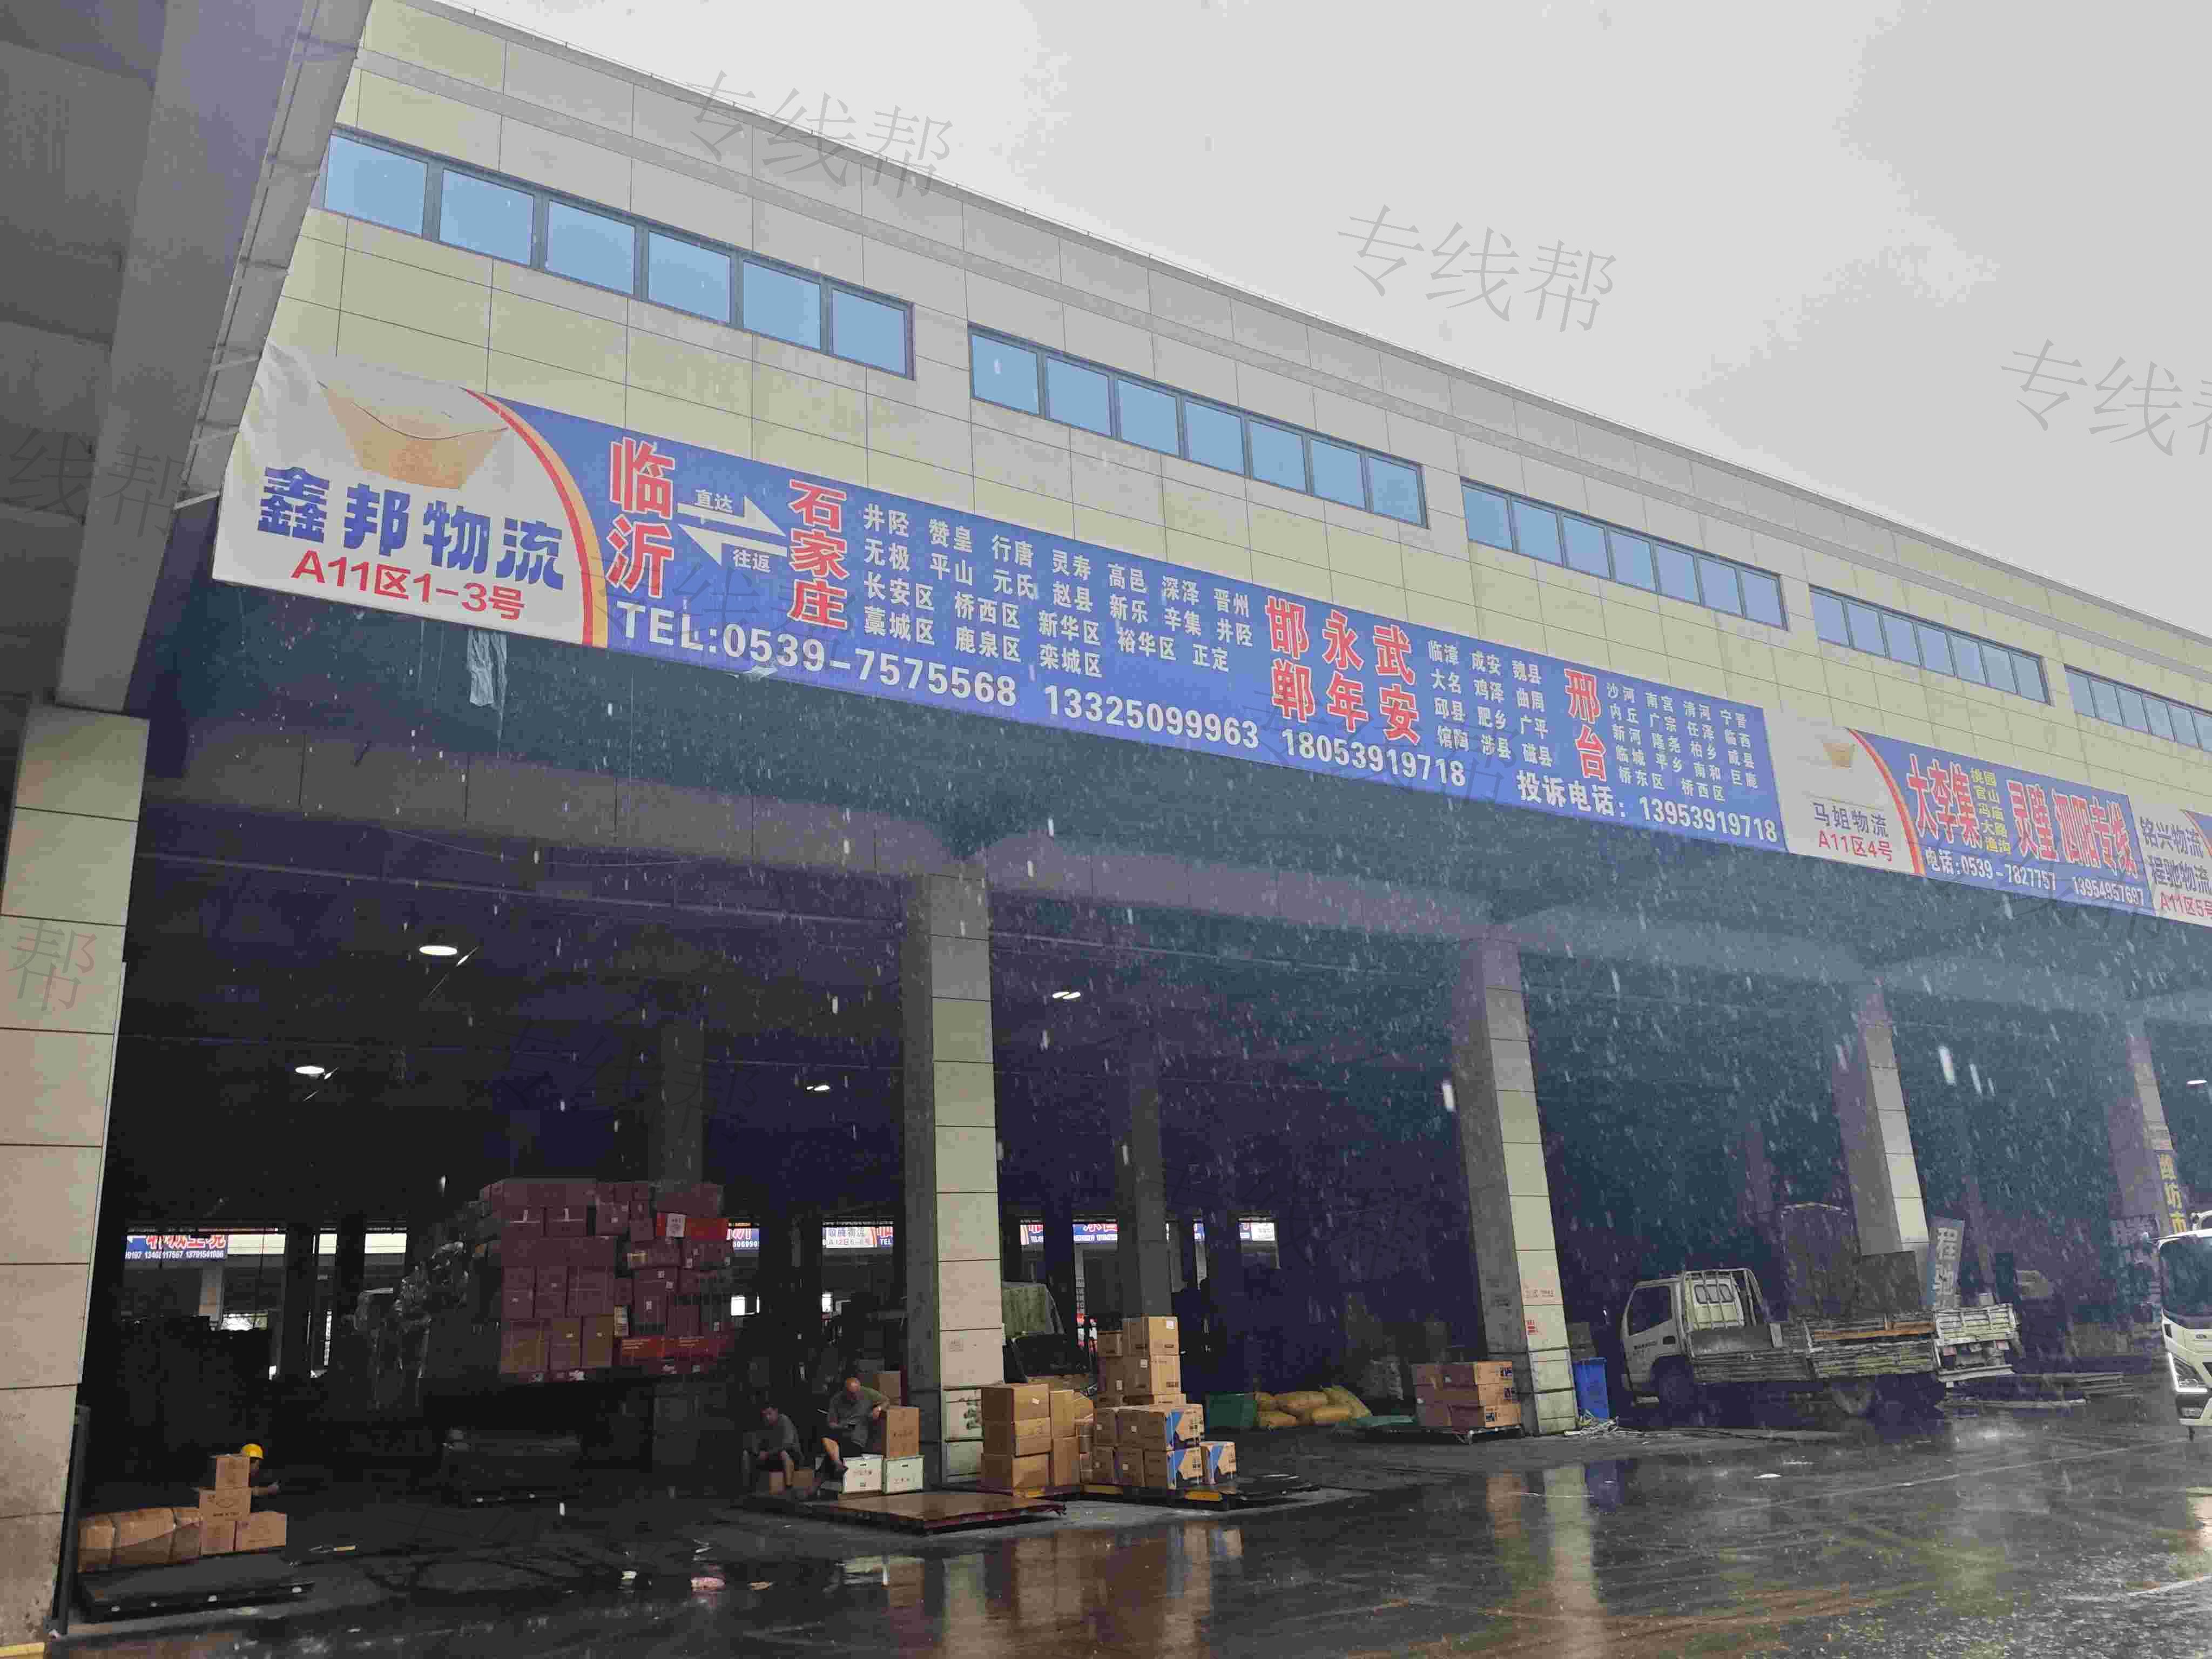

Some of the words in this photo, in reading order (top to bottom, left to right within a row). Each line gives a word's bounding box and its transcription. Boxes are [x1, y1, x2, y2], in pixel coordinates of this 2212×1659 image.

[257, 466, 563, 590] 鑫邦物流
[605, 436, 676, 599] 临沂
[695, 489, 733, 514] 直达
[787, 478, 848, 630] 石家庄
[291, 549, 525, 621] A11区1-3号
[733, 548, 771, 574] 往返
[864, 503, 909, 537] 井陉
[929, 518, 973, 553] 赞皇
[992, 534, 1034, 568] 行唐
[1052, 548, 1091, 581] 灵寿
[1107, 562, 1149, 594] 高邑
[1162, 575, 1199, 605] 深泽
[1213, 588, 1249, 618] 晋州
[864, 538, 910, 572] 无极
[929, 552, 974, 586] 平山
[993, 569, 1036, 600] 元氏
[1053, 581, 1093, 613] 赵县
[1109, 594, 1149, 623] 新乐
[1164, 607, 1202, 637] 辛集
[1217, 618, 1253, 647] 井陉
[864, 571, 934, 611] 长安区
[955, 591, 1020, 629] 桥西区
[1038, 610, 1101, 646] 新华区
[1117, 627, 1177, 661] 裕华区
[1192, 643, 1229, 672] 正定
[955, 626, 1021, 663] 鹿泉区
[1040, 643, 1102, 678] 栾城区
[1265, 595, 1316, 724] 邯郸
[1322, 609, 1369, 733] 永年
[1044, 685, 1259, 750] 13325099963
[1282, 727, 1465, 786] 18053919718
[1372, 624, 1420, 745] 武安
[1563, 668, 1607, 782] 邢台
[1639, 796, 1777, 842] 13953919718
[1818, 830, 1893, 864] A11区4号
